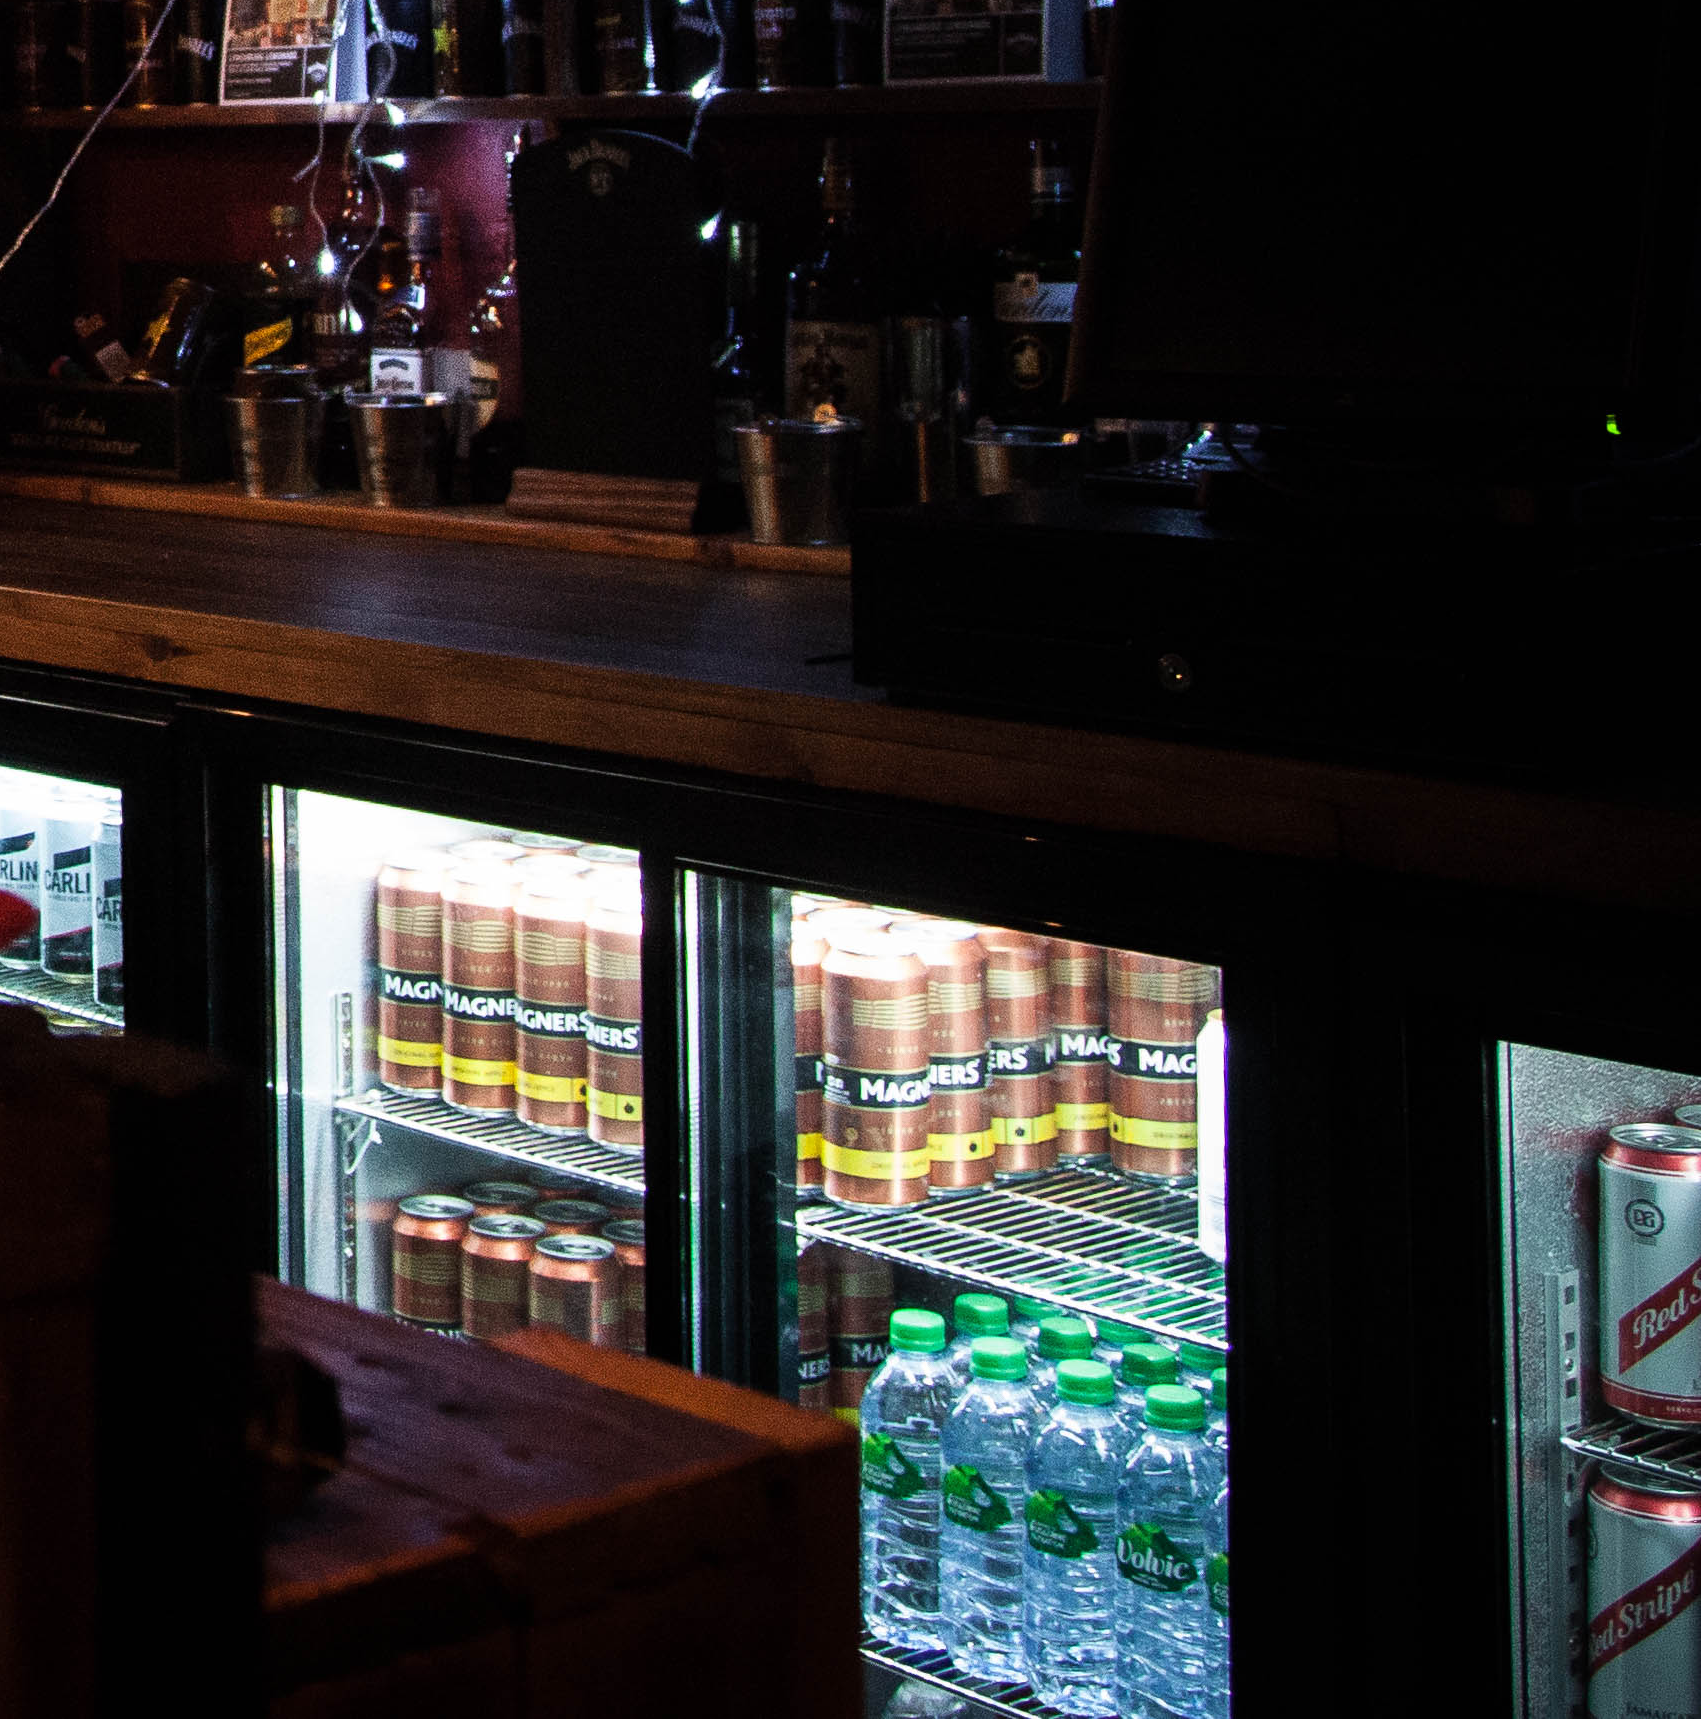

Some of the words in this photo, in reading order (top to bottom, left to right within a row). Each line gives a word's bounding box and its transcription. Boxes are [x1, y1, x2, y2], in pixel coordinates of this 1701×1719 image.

[1632, 1287, 1689, 1349] Red
[1118, 1536, 1191, 1580] Volvic
[1617, 1568, 1696, 1639] Stripe
